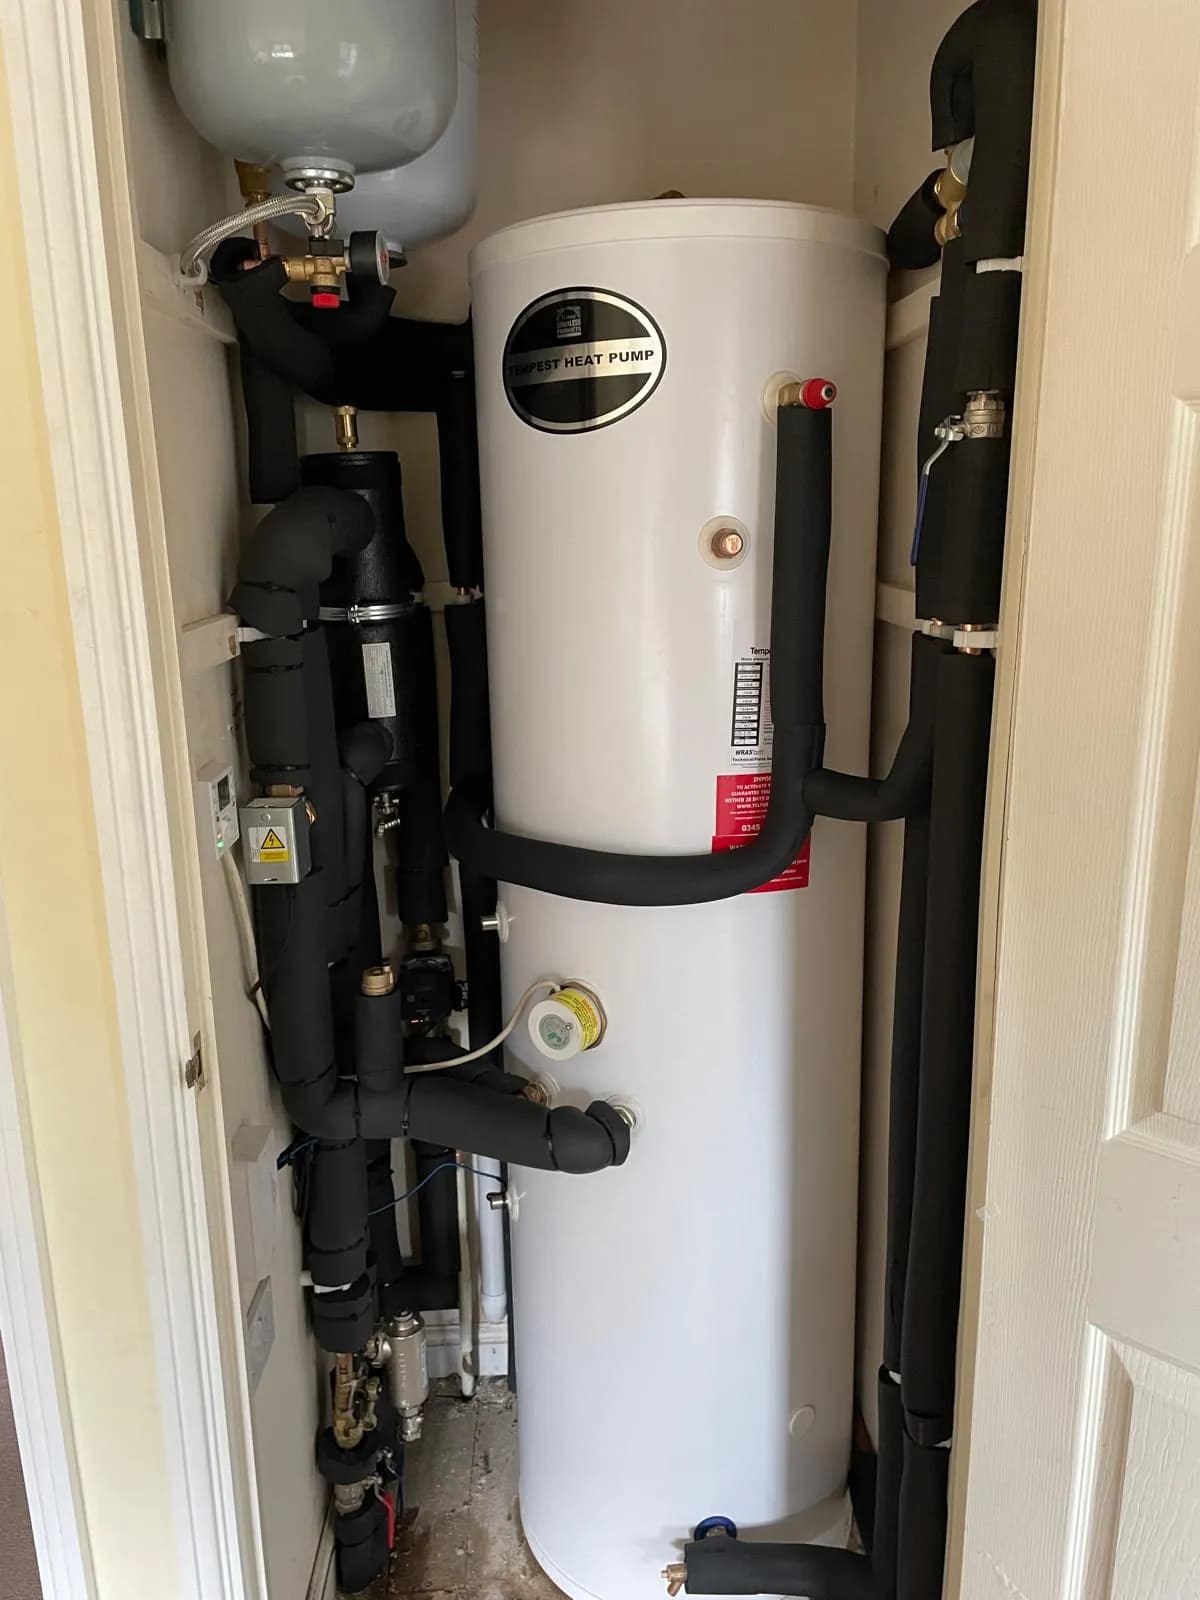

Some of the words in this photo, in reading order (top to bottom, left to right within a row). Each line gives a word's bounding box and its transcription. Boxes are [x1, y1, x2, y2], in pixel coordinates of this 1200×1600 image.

[505, 358, 561, 376] TEMPEST
[564, 354, 603, 368] HEAT
[608, 350, 655, 363] PUMP
